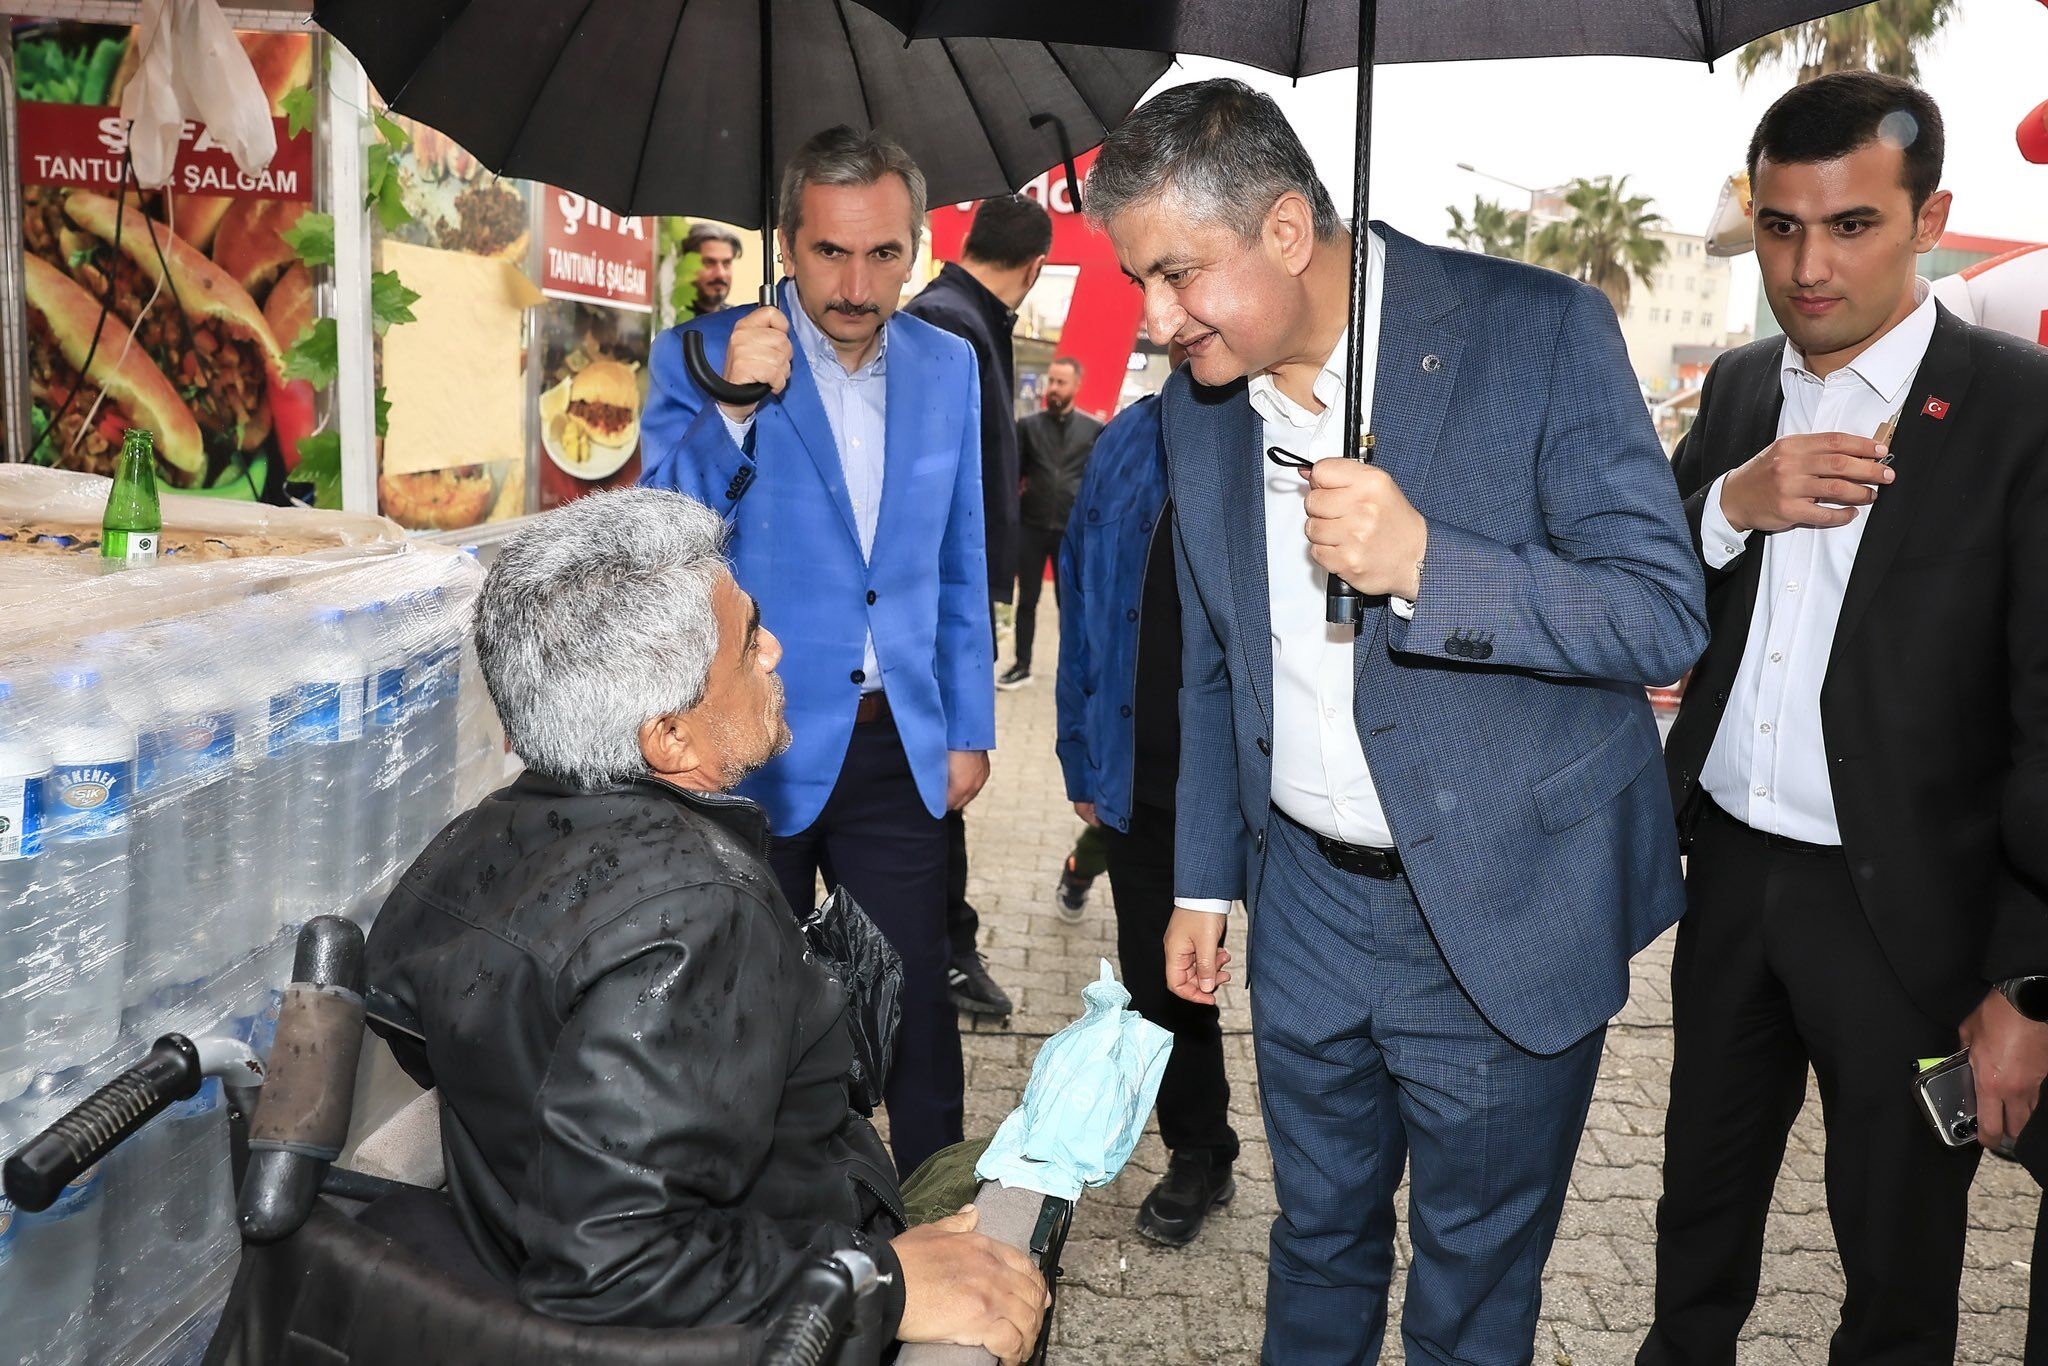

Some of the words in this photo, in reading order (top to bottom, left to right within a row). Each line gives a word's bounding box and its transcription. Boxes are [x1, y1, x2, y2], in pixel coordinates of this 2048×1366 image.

[34, 155, 136, 184] TANTU
[596, 258, 605, 288] &
[54, 768, 117, 793] RKENEK
